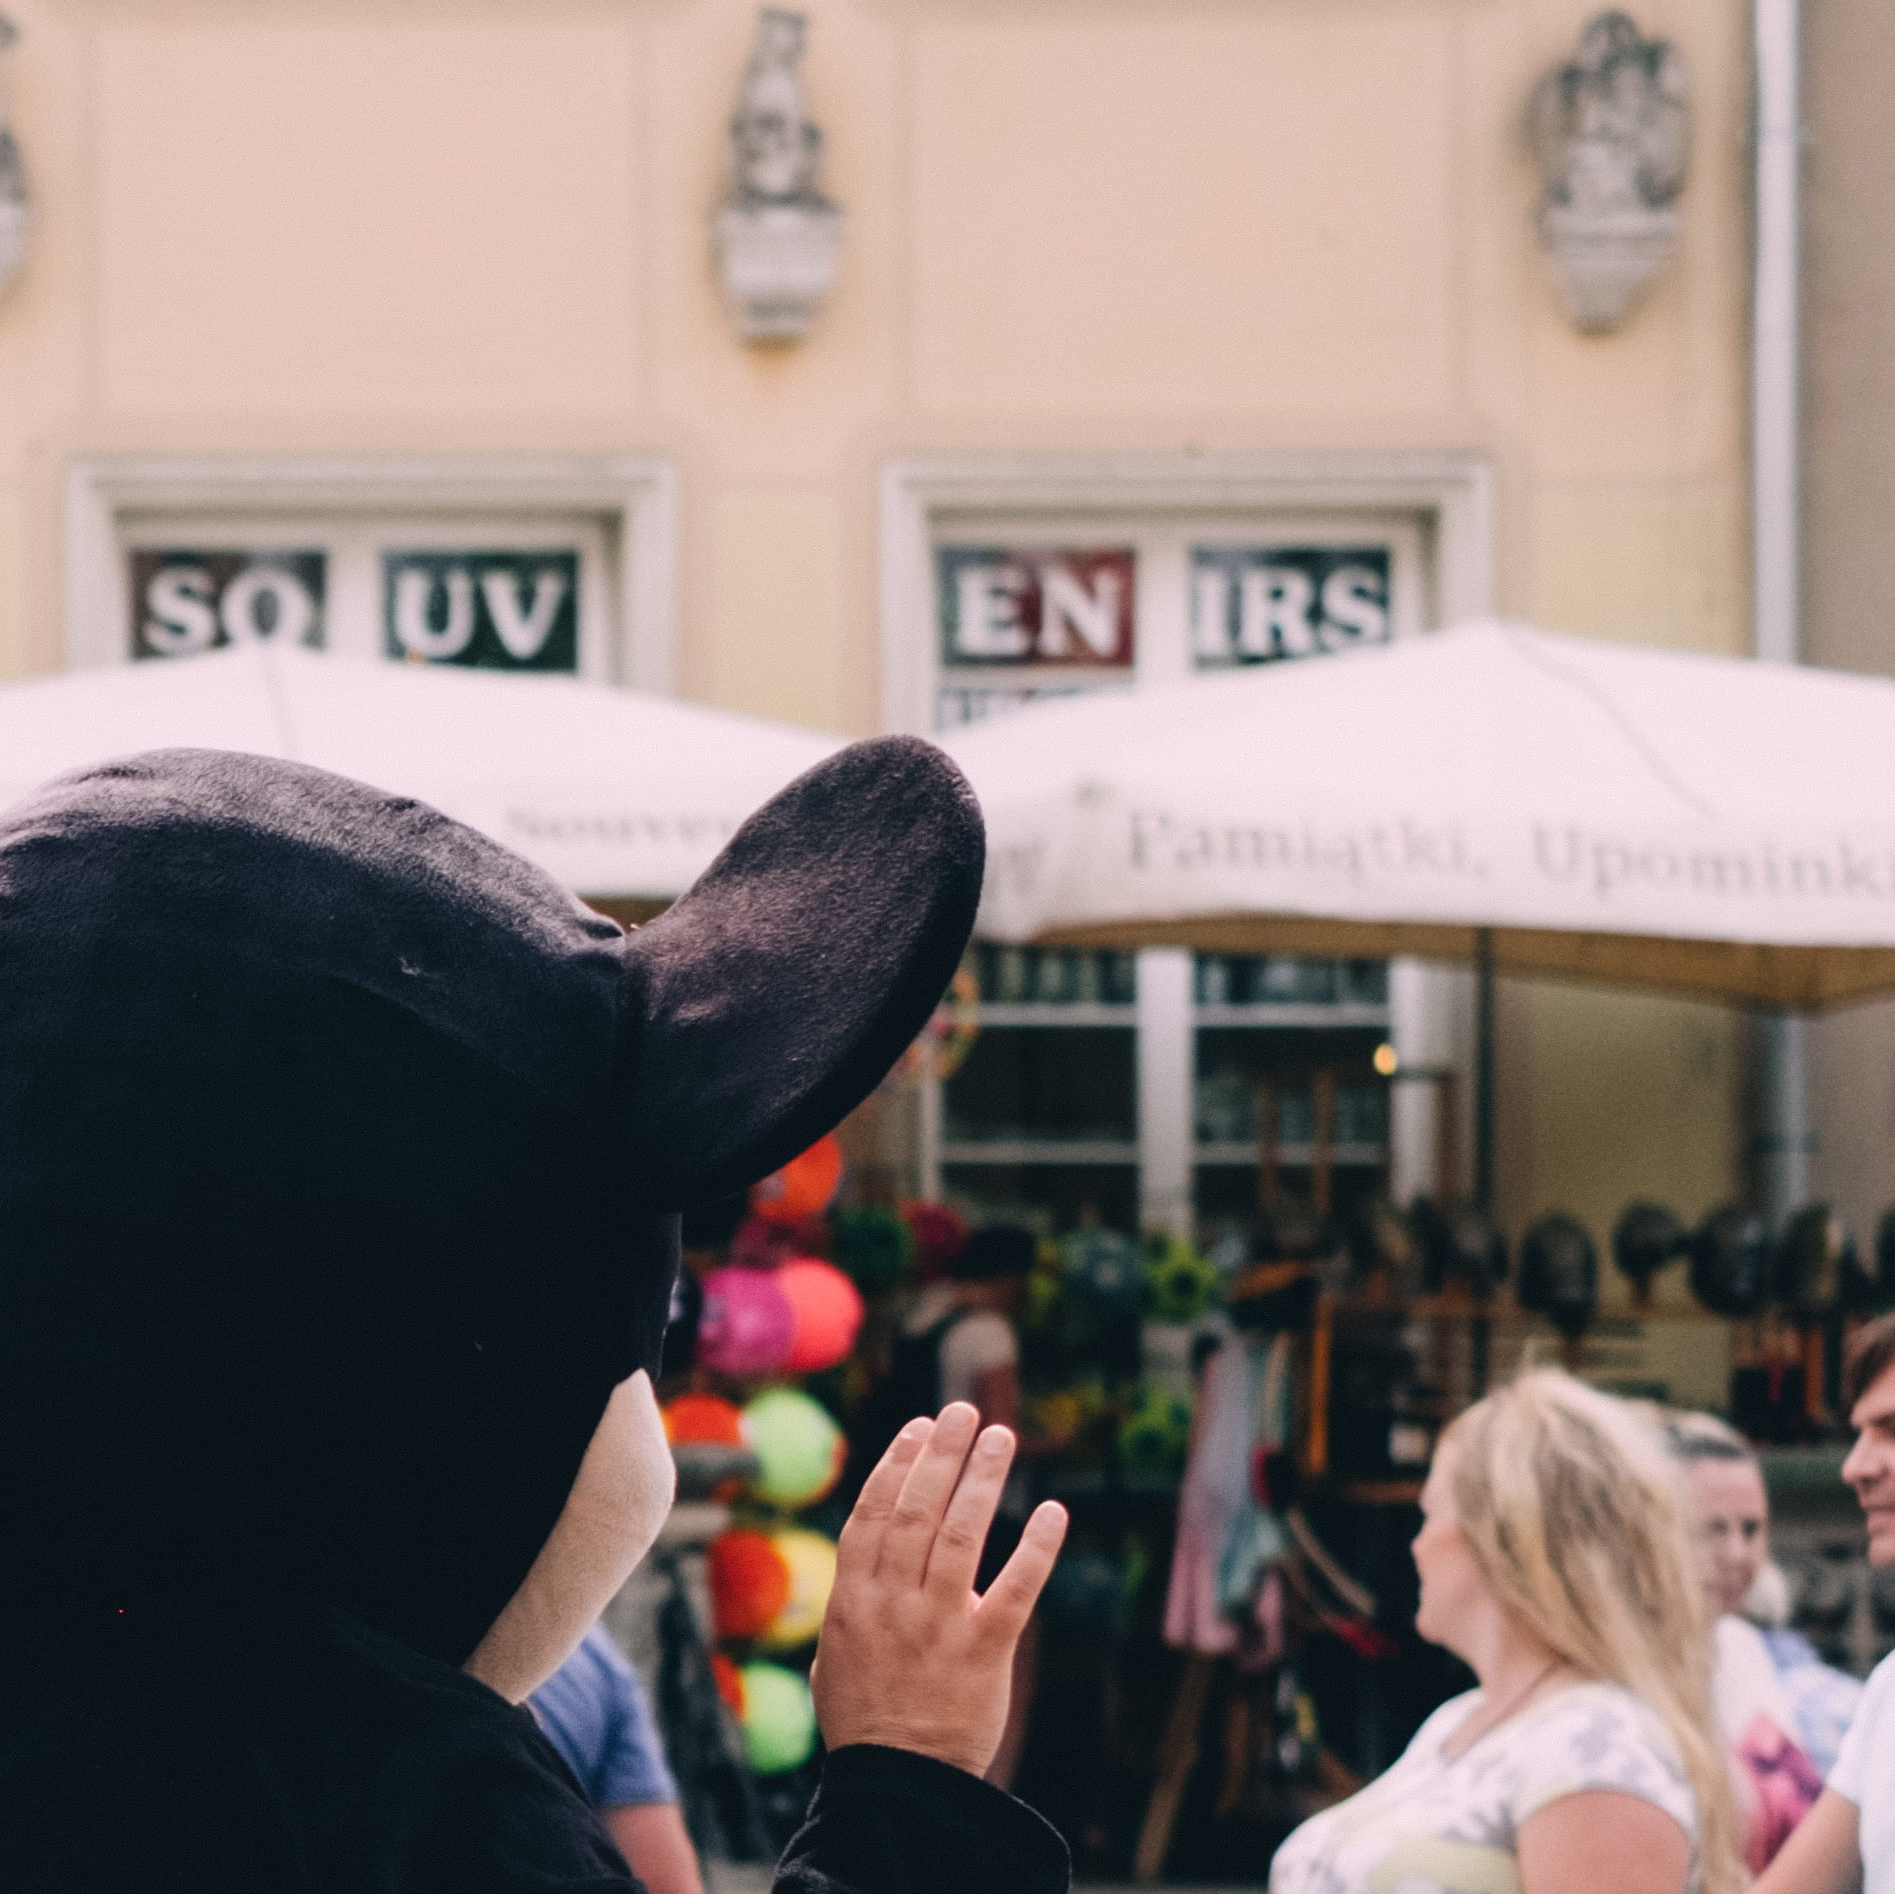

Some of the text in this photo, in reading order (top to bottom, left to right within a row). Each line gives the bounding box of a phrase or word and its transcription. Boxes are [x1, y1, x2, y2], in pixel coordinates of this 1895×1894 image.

[146, 564, 1385, 660] SO UV EN IRS
